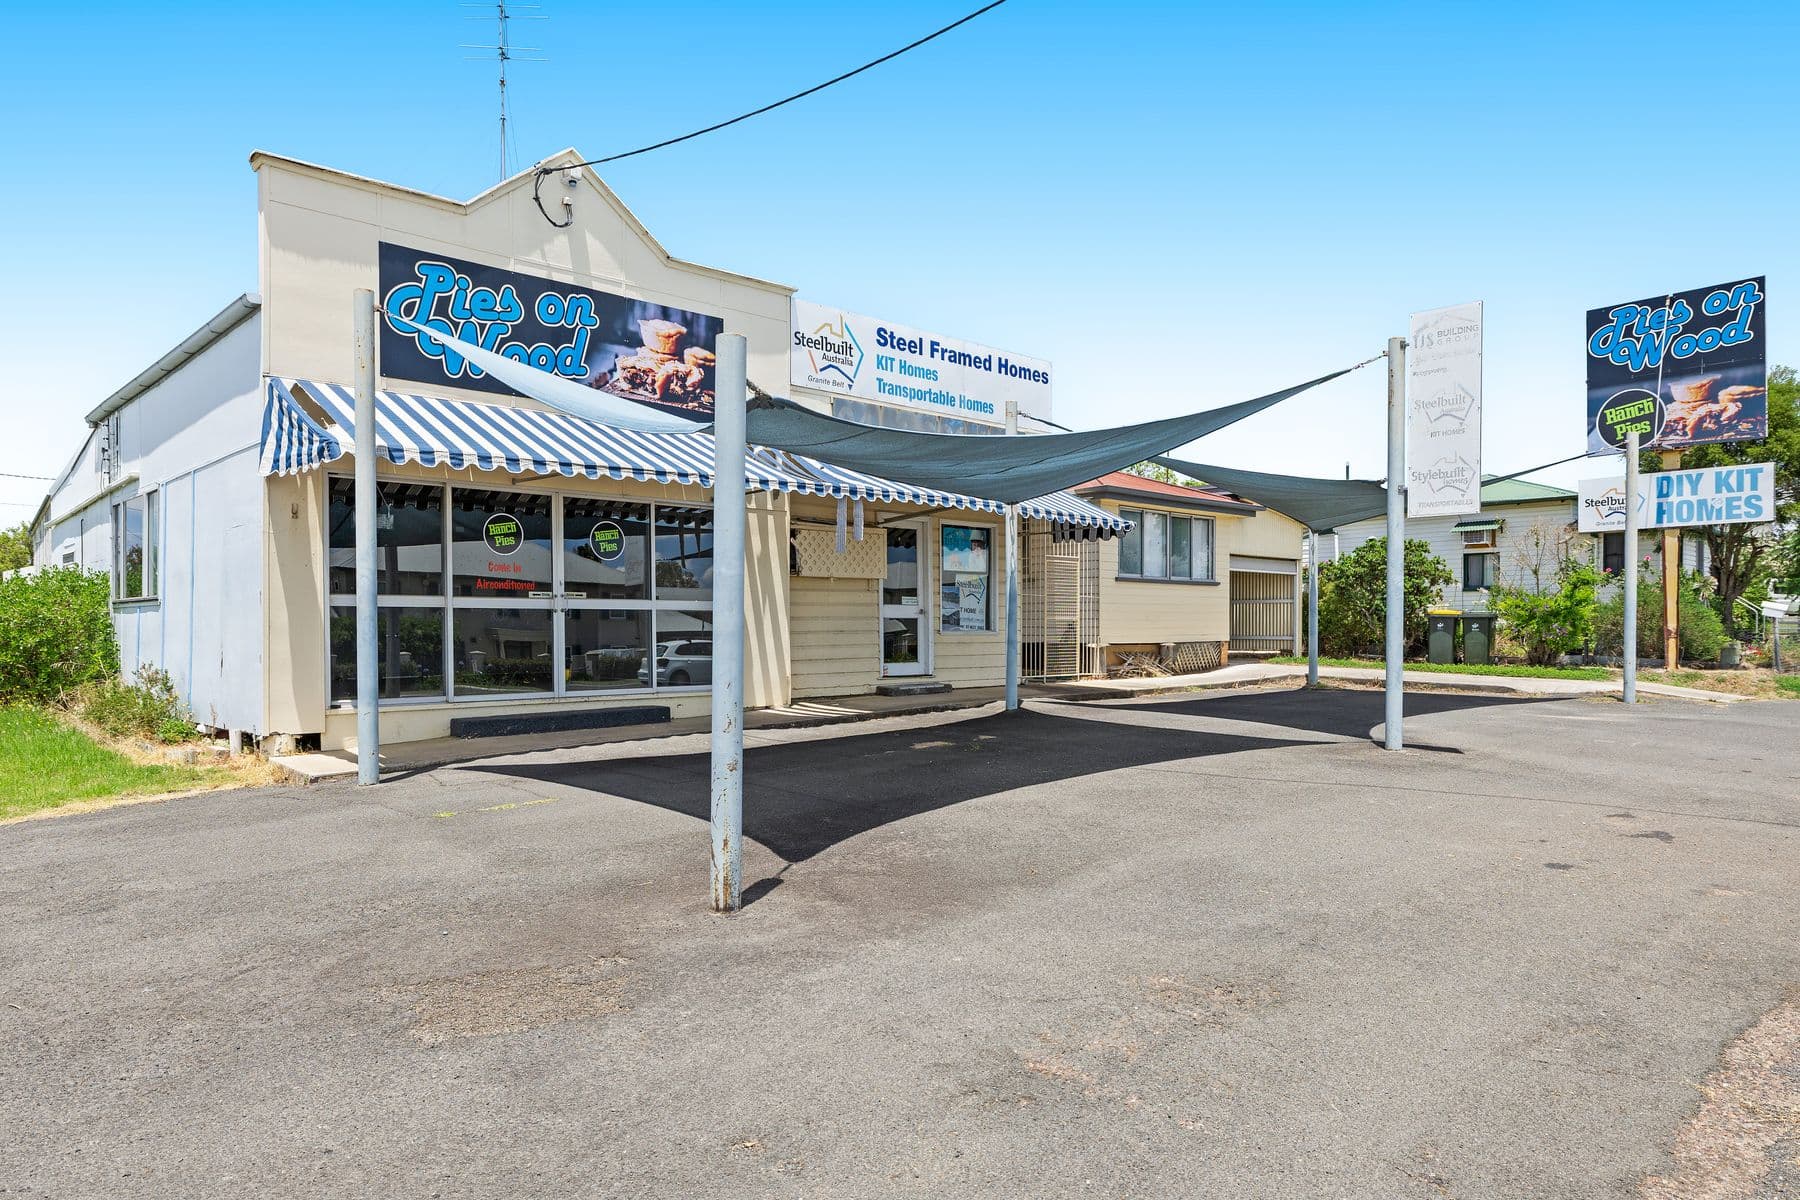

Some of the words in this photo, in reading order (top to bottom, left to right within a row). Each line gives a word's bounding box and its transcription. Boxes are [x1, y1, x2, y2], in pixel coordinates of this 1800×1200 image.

[384, 260, 524, 336] Pies
[536, 291, 601, 328] on
[1589, 300, 1693, 358] Pies
[1704, 278, 1763, 316] on
[1436, 324, 1479, 338] BUILDING
[1611, 304, 1754, 373] Wood
[415, 317, 591, 380] Wood
[794, 331, 854, 358] Steelbuilt
[822, 353, 854, 367] Australia
[875, 326, 924, 356] Steel
[929, 340, 993, 372] Framed
[997, 356, 1050, 385] Homes
[876, 354, 896, 373] KIT
[899, 359, 939, 382] Homes
[807, 374, 831, 386] Granite
[831, 379, 845, 388] Belt
[876, 377, 956, 409] Transportable
[958, 394, 995, 415] Homes
[1413, 393, 1466, 410] Steelbuilt
[1603, 397, 1655, 425] Ranch
[1614, 420, 1652, 440] Pies
[1411, 466, 1466, 484] Stylebuilt
[1656, 472, 1705, 499] DIY
[1714, 466, 1764, 494] KIT
[1584, 496, 1628, 508] Steelbu
[1655, 494, 1764, 526] HOMES
[488, 521, 517, 536] Ranch
[594, 529, 619, 542] Ranch
[494, 535, 516, 547] Pies
[599, 540, 618, 552] Pies
[476, 578, 536, 590] Airconditioned
